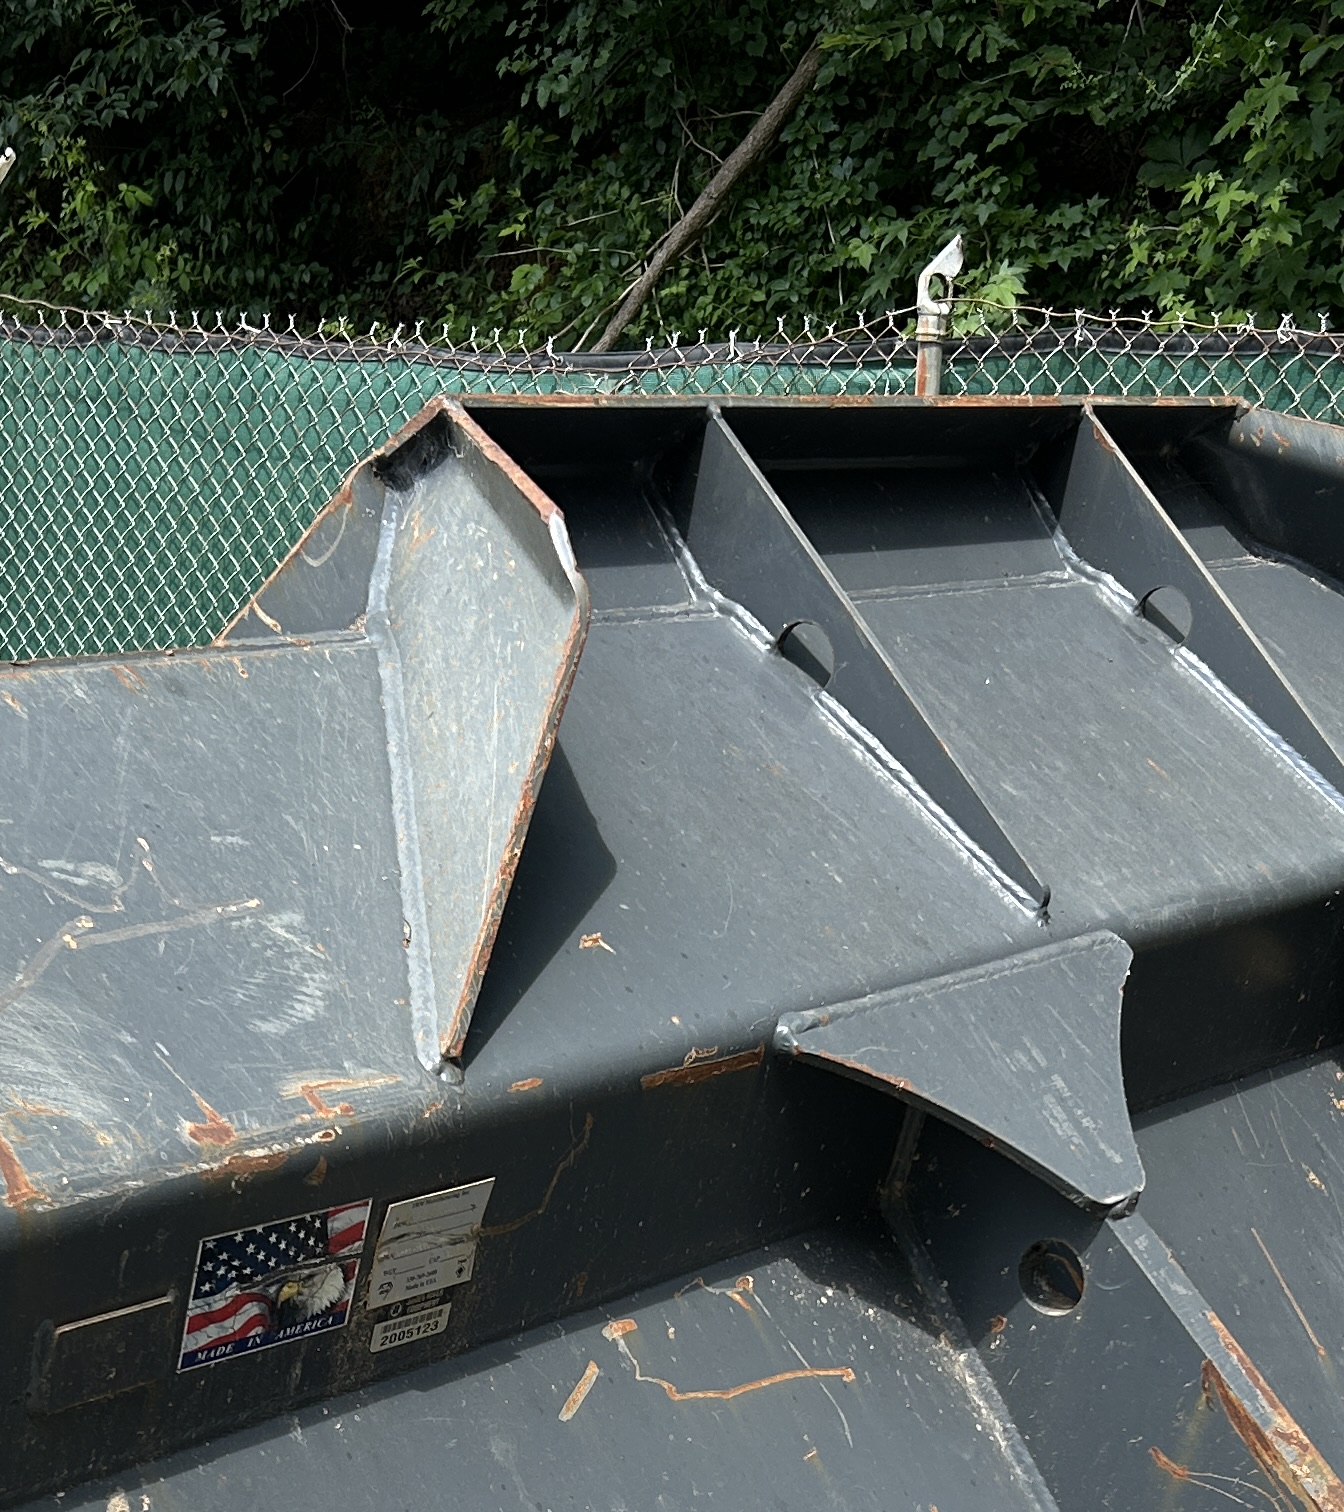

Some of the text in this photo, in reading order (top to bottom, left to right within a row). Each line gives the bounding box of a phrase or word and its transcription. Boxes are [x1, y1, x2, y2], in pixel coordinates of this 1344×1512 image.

[194, 1316, 333, 1363] MADE IN AMERICA
[379, 1320, 440, 1347] 2005123
